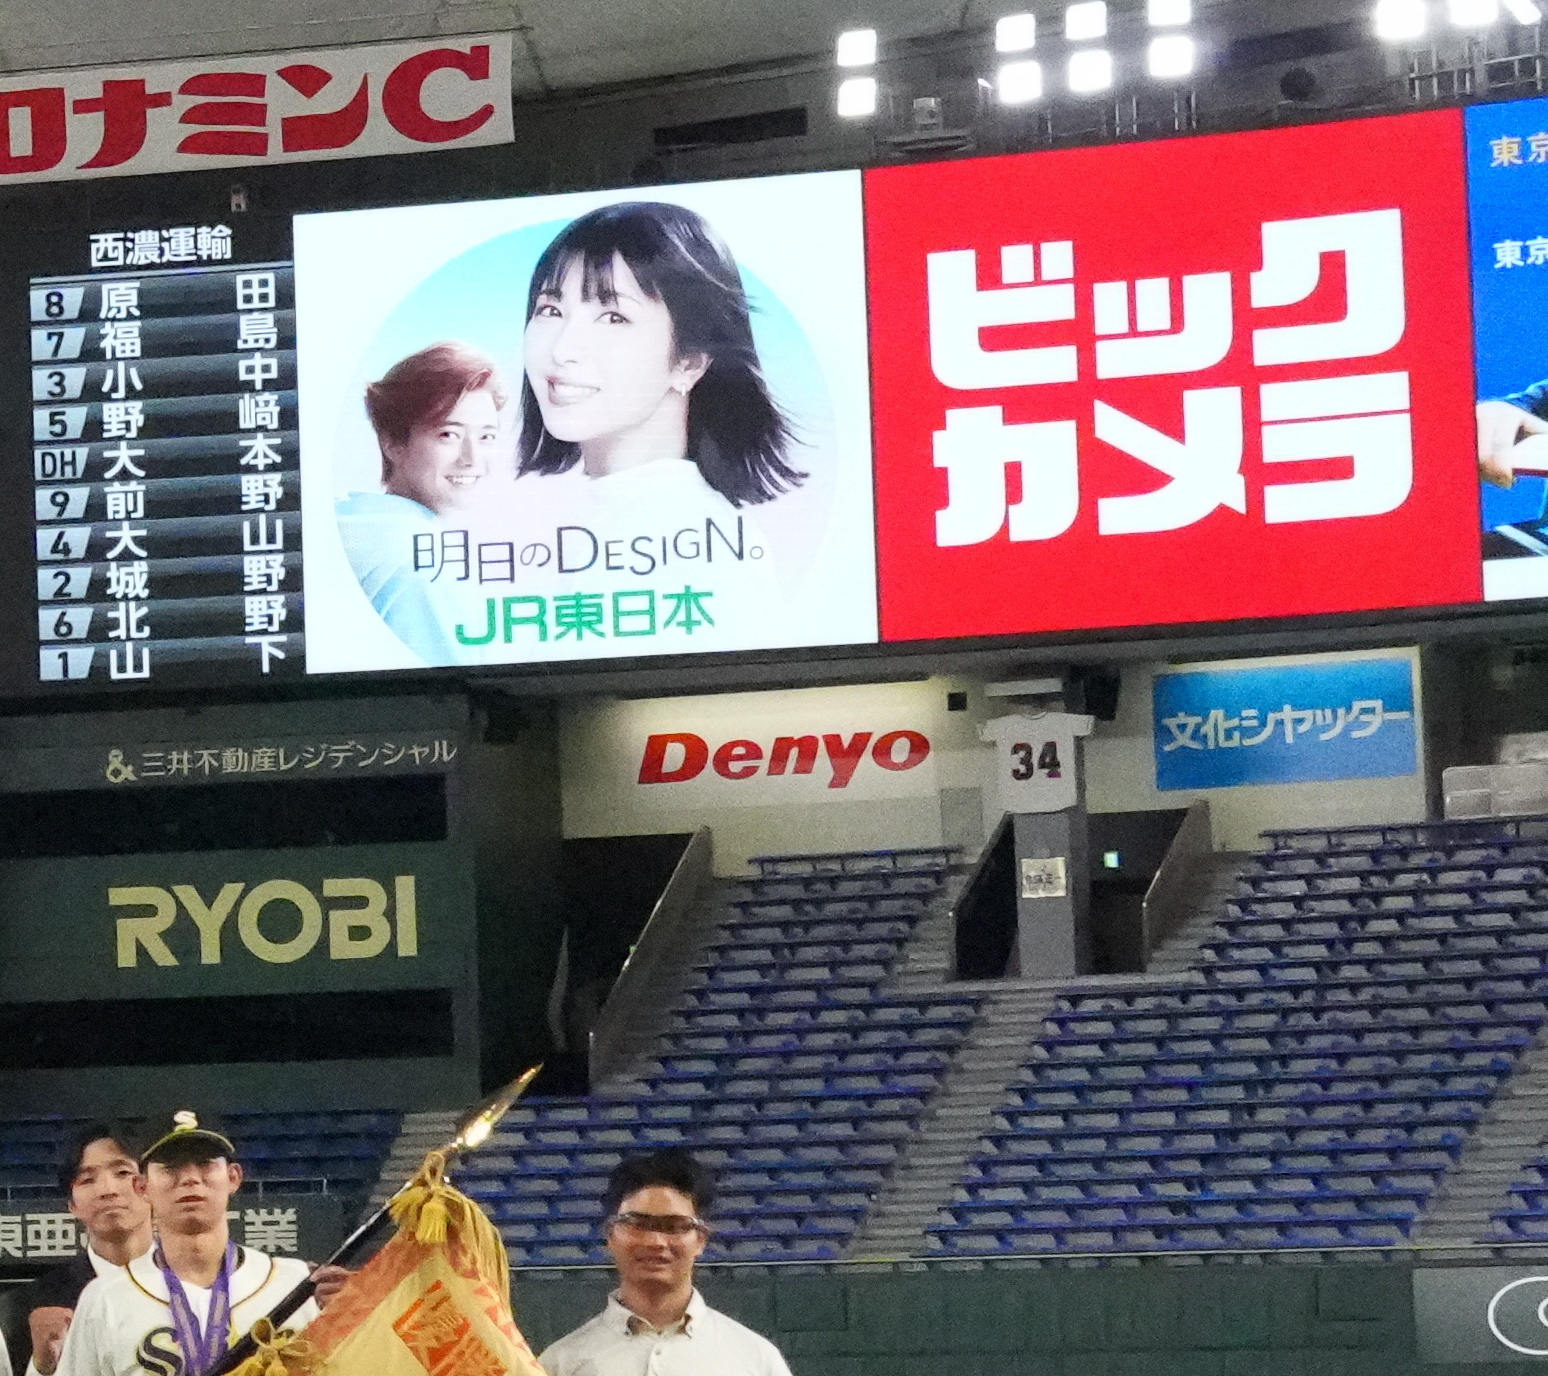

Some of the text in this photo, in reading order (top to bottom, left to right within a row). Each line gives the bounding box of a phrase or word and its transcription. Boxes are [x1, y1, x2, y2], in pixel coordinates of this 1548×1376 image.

[90, 224, 232, 268] 西濃運輸
[45, 291, 65, 318] 8
[927, 207, 1406, 392] ビック
[45, 331, 65, 358] 7
[47, 371, 66, 398] 3
[48, 411, 68, 438] 5
[40, 451, 78, 479] DH
[932, 370, 1414, 548] カメラ
[50, 491, 70, 517] 9
[49, 531, 71, 558] 4
[53, 571, 72, 599] 2
[53, 611, 73, 638] 6
[455, 585, 715, 646] JR東日本
[57, 652, 68, 678] 1
[141, 739, 457, 778] 三井不動産レジデンシャル
[637, 728, 931, 788] Denyo
[1010, 740, 1061, 781] 34
[107, 874, 418, 968] RYOBI
